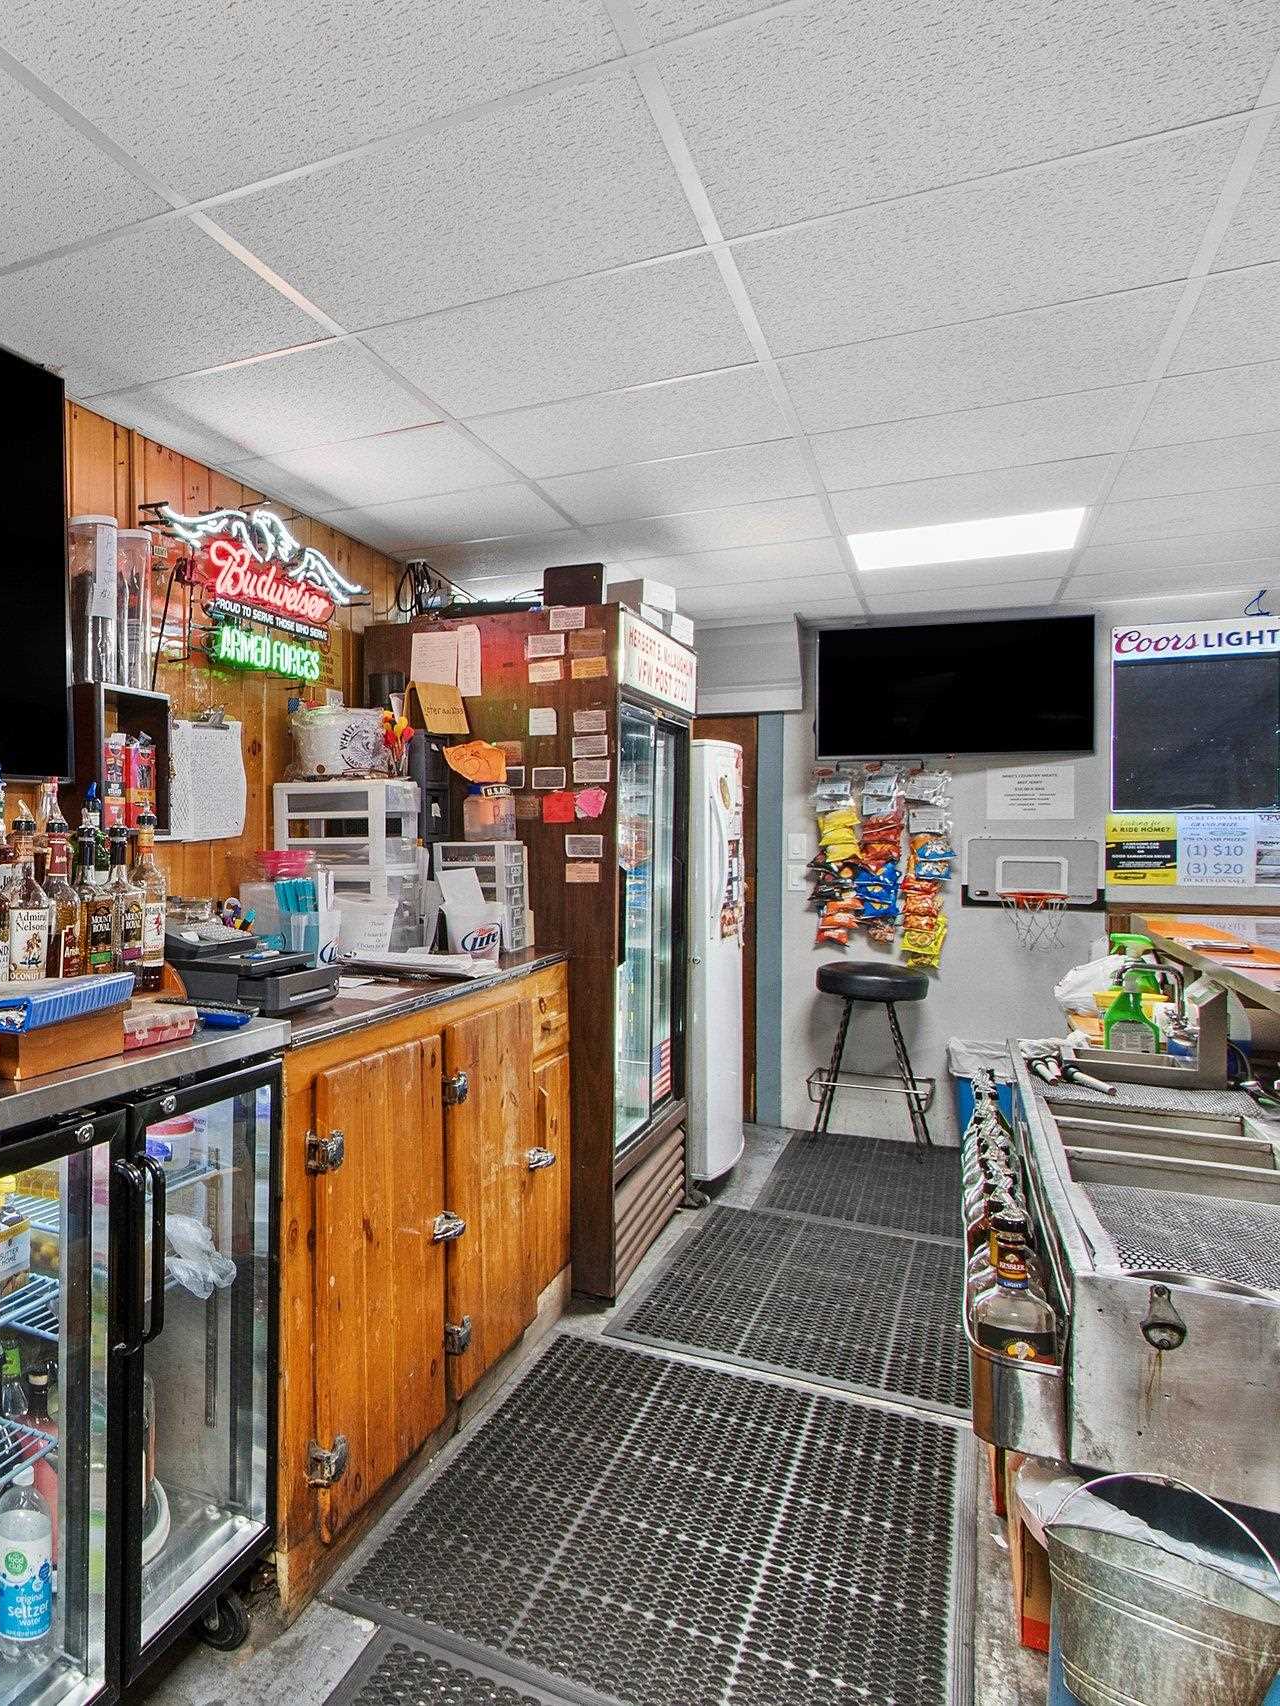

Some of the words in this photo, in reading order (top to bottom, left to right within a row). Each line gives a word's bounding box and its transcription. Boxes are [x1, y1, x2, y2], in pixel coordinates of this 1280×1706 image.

[210, 541, 330, 619] Budweiser
[216, 598, 241, 613] PROUD
[242, 604, 252, 617] TO
[253, 609, 274, 625] SERVE
[275, 617, 295, 631] THOSE
[295, 624, 309, 636] WHO
[310, 627, 328, 640] SERVE
[220, 626, 272, 668] ARMED
[272, 640, 320, 680] FORCES
[1114, 630, 1200, 654] Coors
[1203, 629, 1280, 649] LIGHT
[1187, 845, 1207, 858] (1)
[1213, 844, 1244, 857] $10
[1187, 862, 1207, 875] (3)
[1213, 862, 1244, 874] $20
[8, 1601, 48, 1618] seltzer
